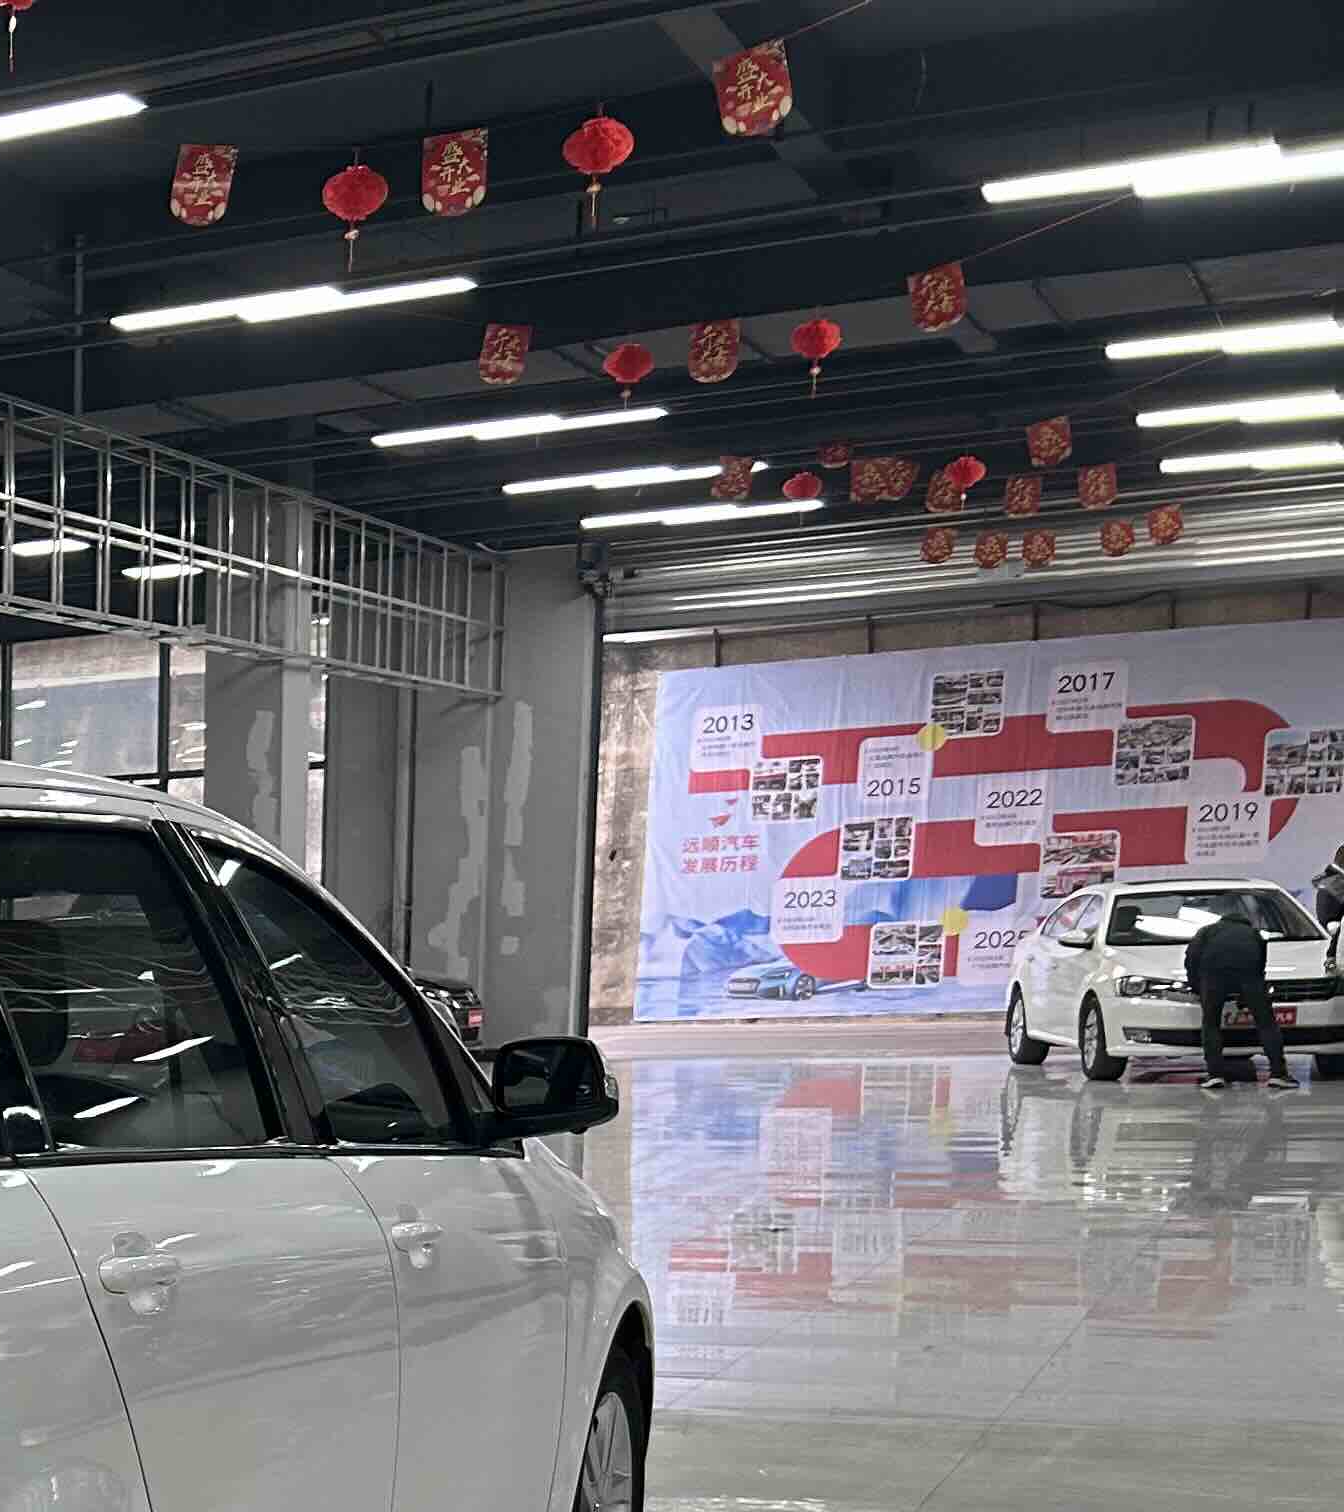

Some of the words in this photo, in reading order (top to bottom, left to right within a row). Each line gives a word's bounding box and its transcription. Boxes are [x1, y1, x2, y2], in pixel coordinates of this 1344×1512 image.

[1057, 671, 1116, 693] 2017
[703, 713, 755, 734] 2013
[866, 777, 922, 797] 2015
[986, 788, 1043, 809] 2022
[1199, 801, 1259, 823] 2019
[680, 832, 761, 854] 远顺汽车
[680, 854, 761, 875] 发展历程
[783, 888, 837, 909] 2023
